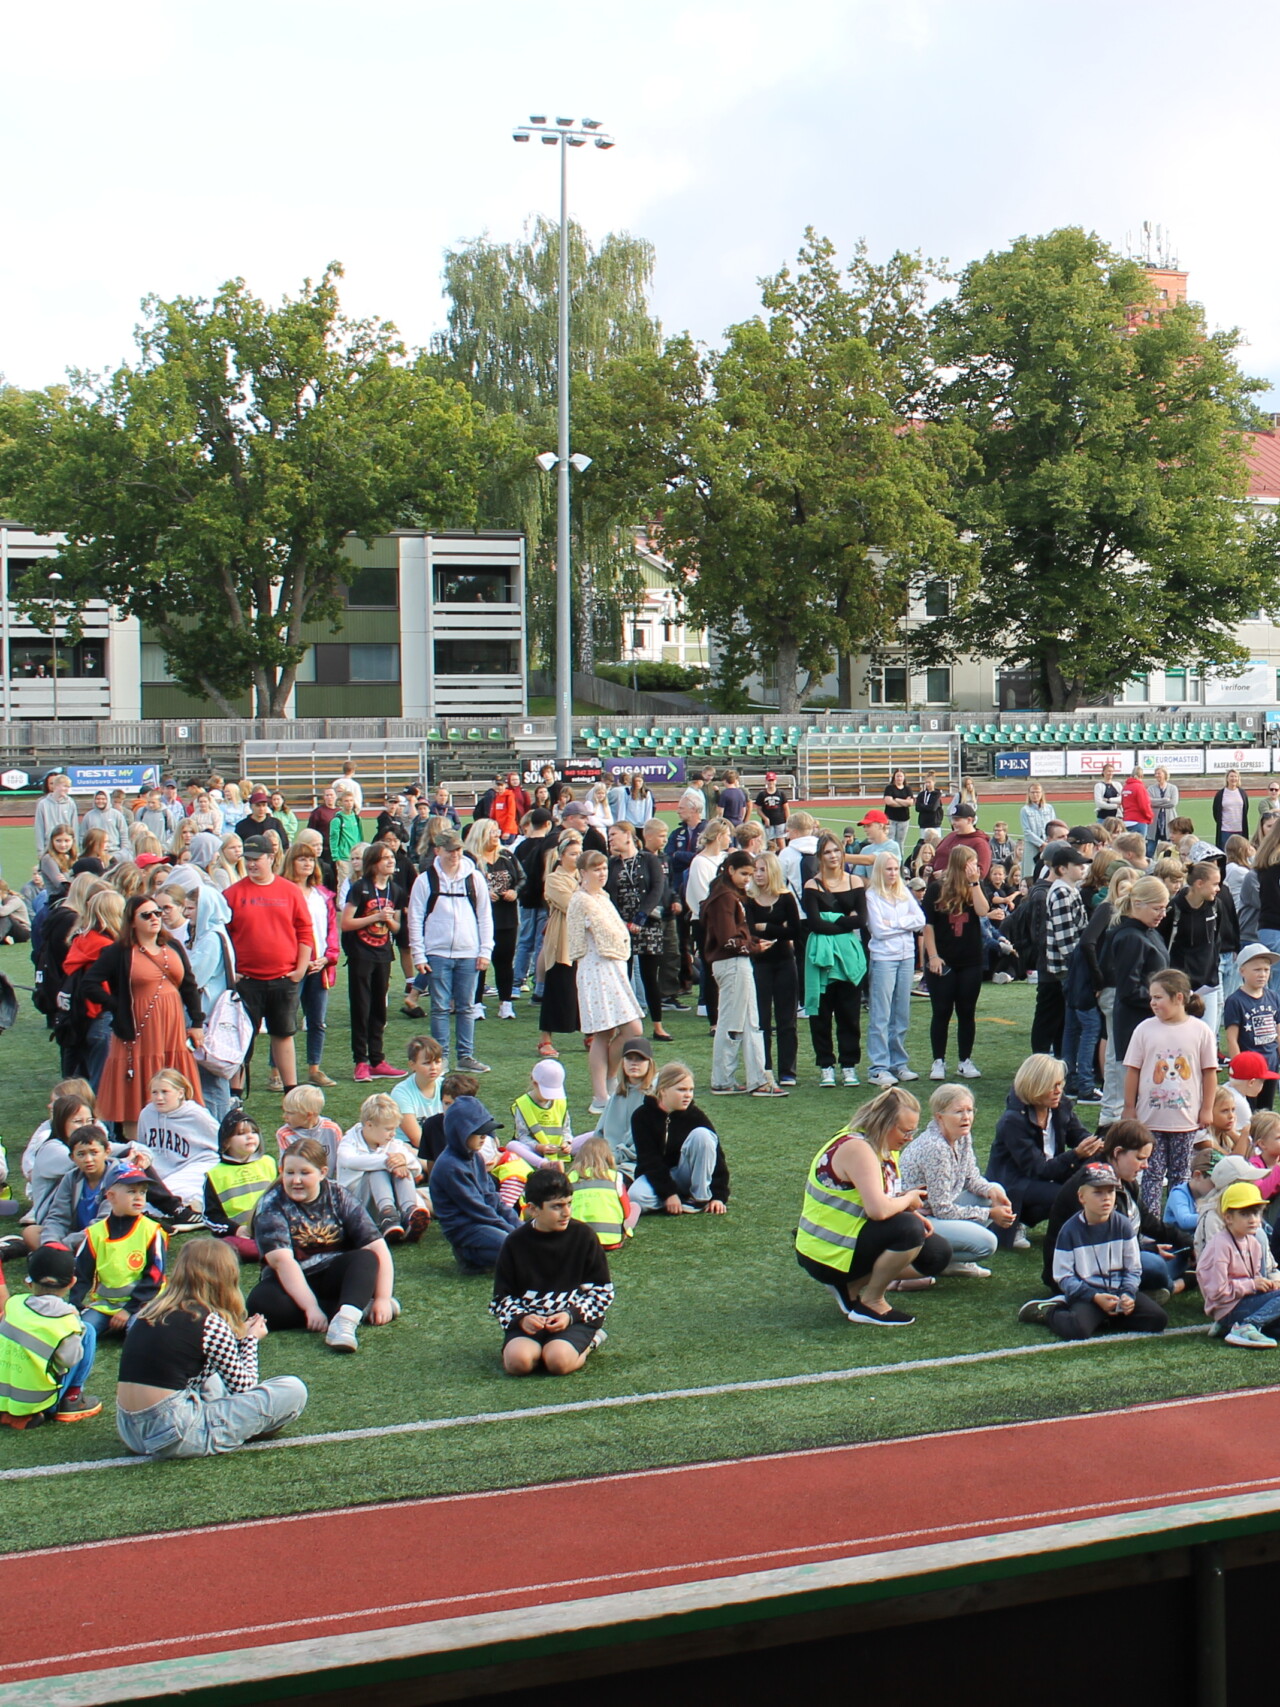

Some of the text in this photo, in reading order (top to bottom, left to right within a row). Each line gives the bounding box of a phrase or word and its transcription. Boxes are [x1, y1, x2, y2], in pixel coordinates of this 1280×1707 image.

[1155, 755, 1199, 763] EUROMASTER
[77, 769, 117, 777] NESTE
[612, 765, 666, 775] GIGANTTI
